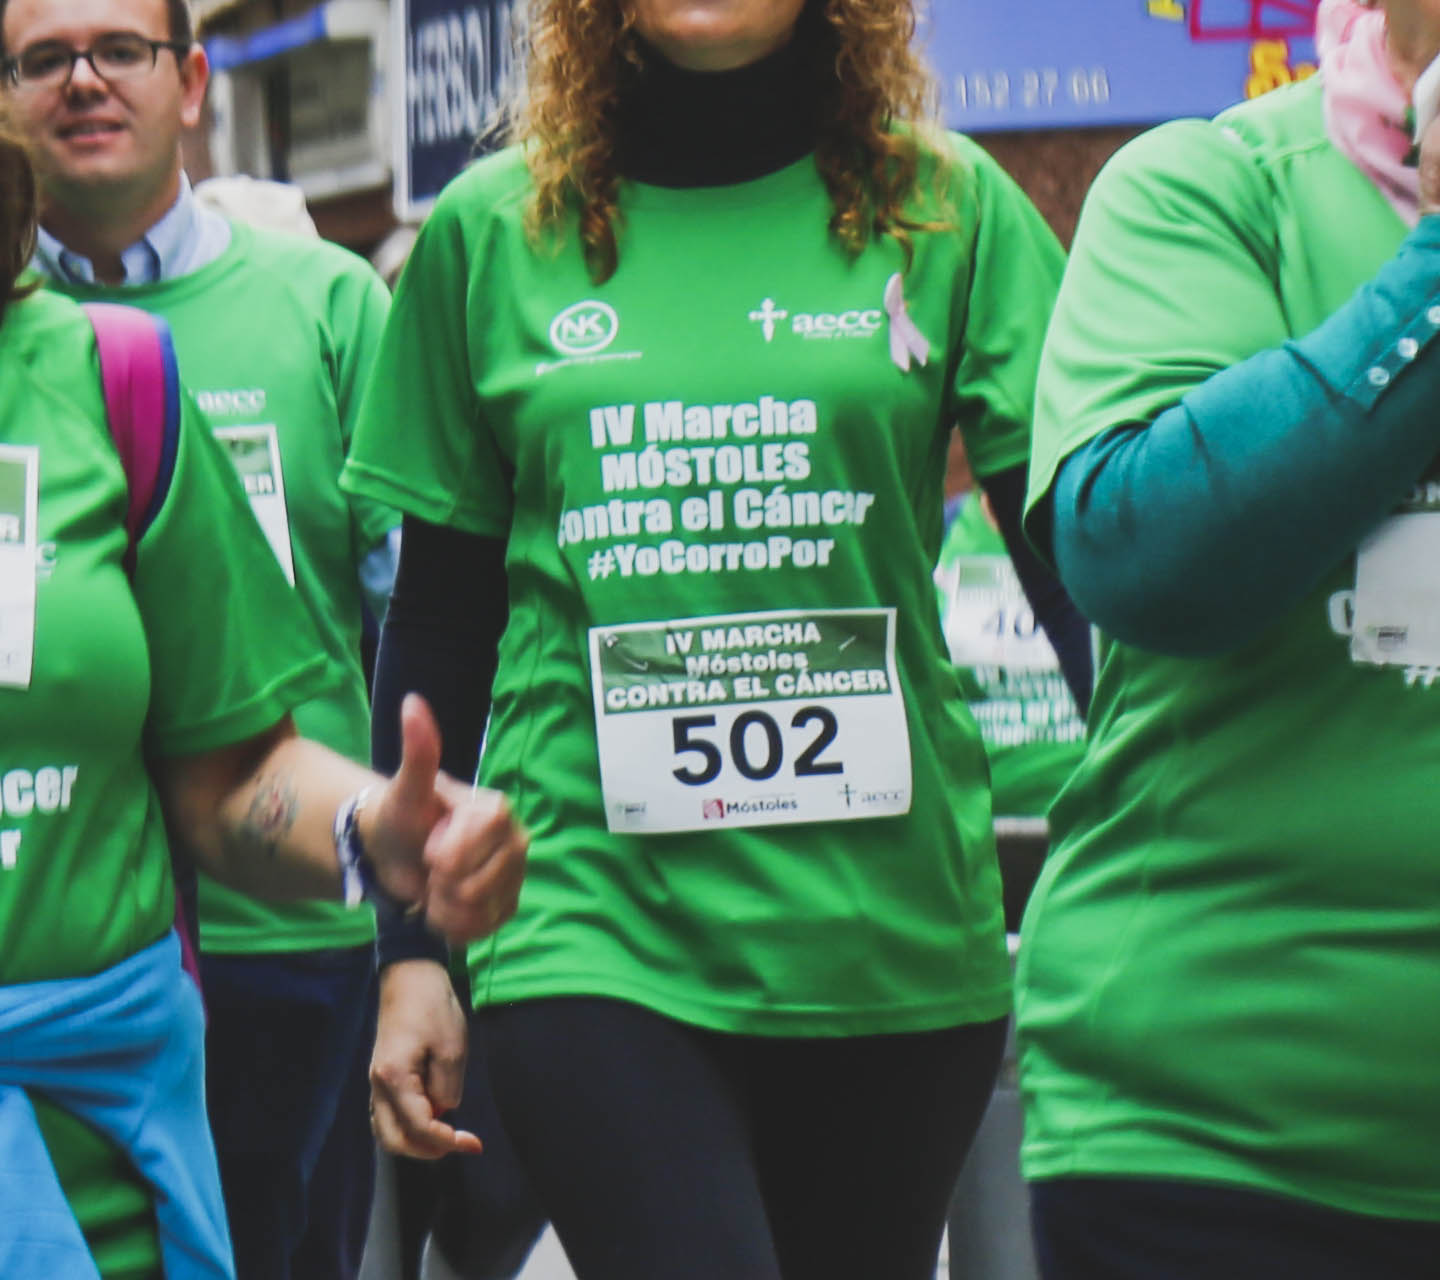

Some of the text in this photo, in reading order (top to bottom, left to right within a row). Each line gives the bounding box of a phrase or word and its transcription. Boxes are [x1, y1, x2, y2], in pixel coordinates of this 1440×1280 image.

[793, 310, 882, 333] aecc
[589, 396, 816, 448] IV Marcha
[601, 442, 810, 492] MÓSTOLES
[557, 498, 673, 548] ontra
[681, 490, 724, 531] el
[587, 536, 834, 581] #YoCorroPor
[666, 623, 821, 656] IV MARCHA
[686, 650, 808, 675] Móstoles
[607, 669, 888, 708] CONTRA EL CÁNCER
[672, 706, 843, 786] 502
[726, 800, 798, 814] Móstoles
